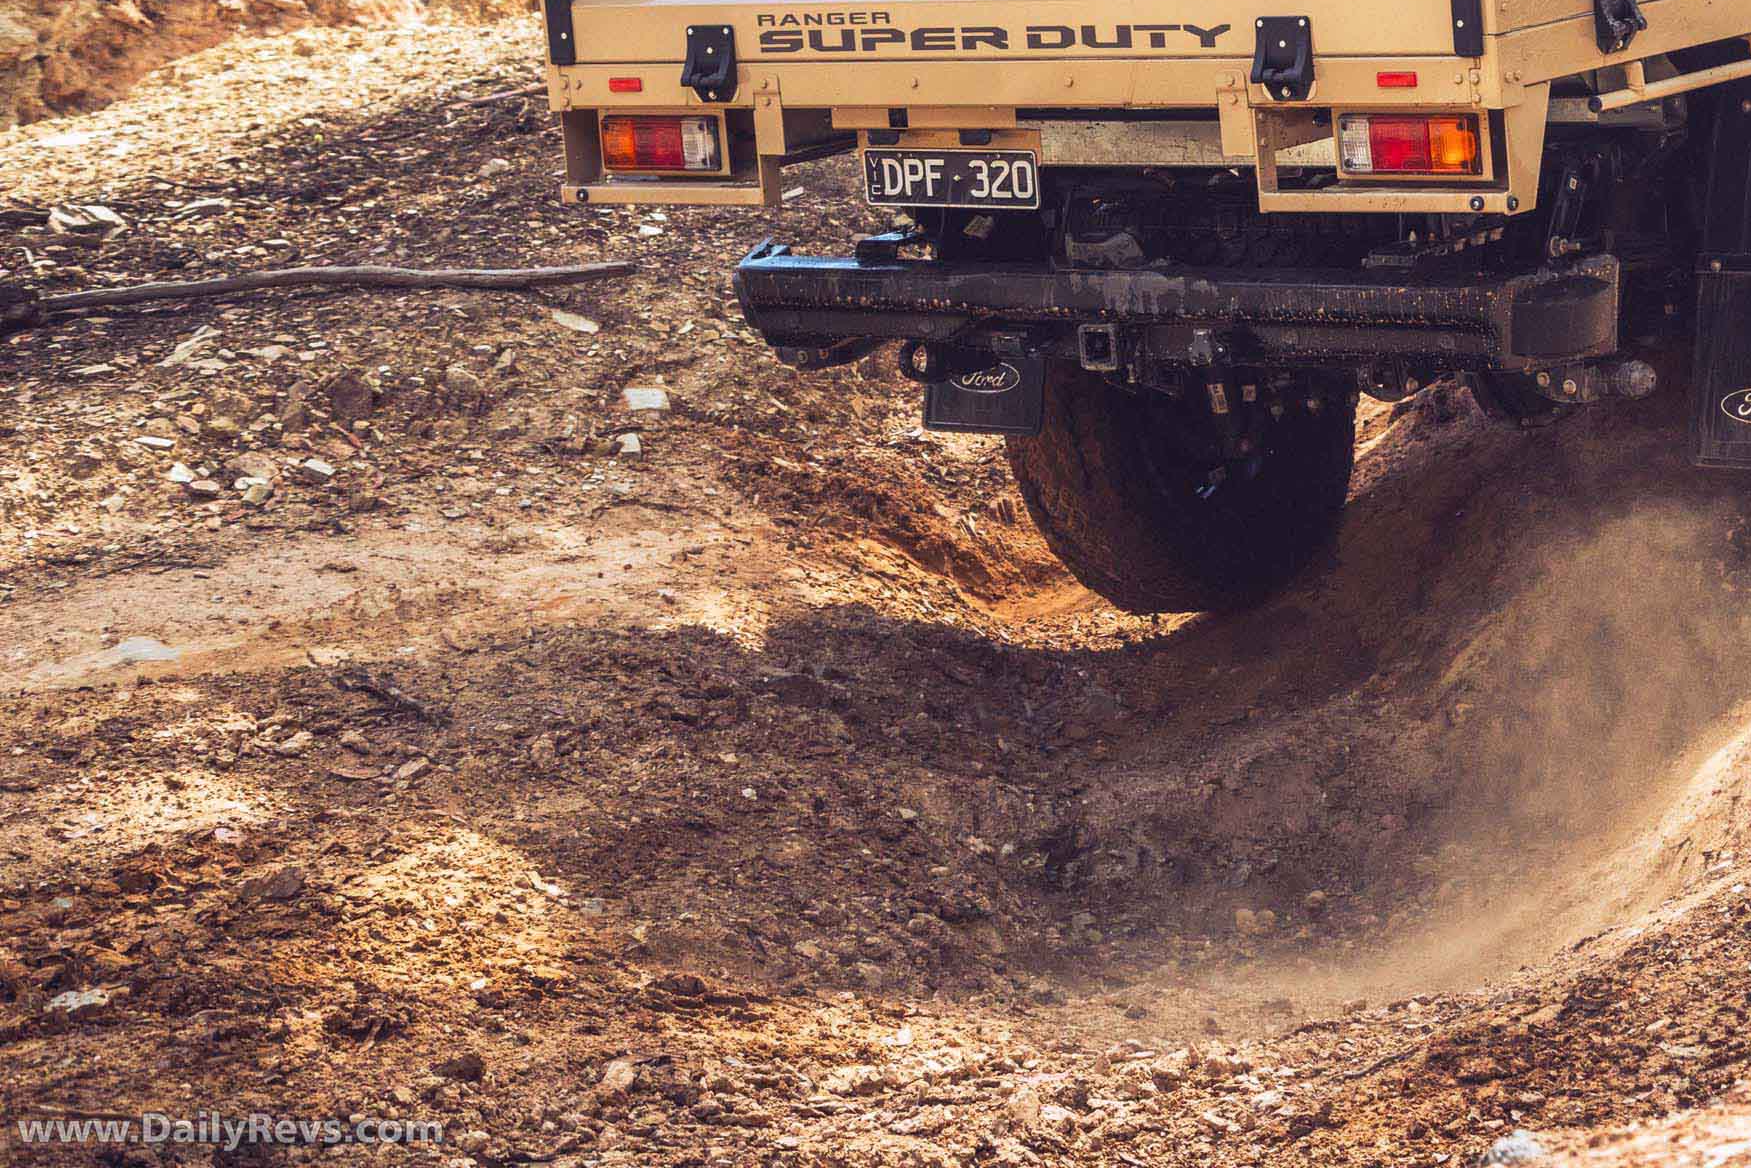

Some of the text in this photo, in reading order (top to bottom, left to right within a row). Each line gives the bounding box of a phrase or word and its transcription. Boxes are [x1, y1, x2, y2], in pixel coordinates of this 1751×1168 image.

[757, 11, 891, 26] RANGER
[759, 24, 1232, 53] SUPER DUTY
[869, 156, 882, 195] VIC
[881, 157, 1034, 199] DPF 320
